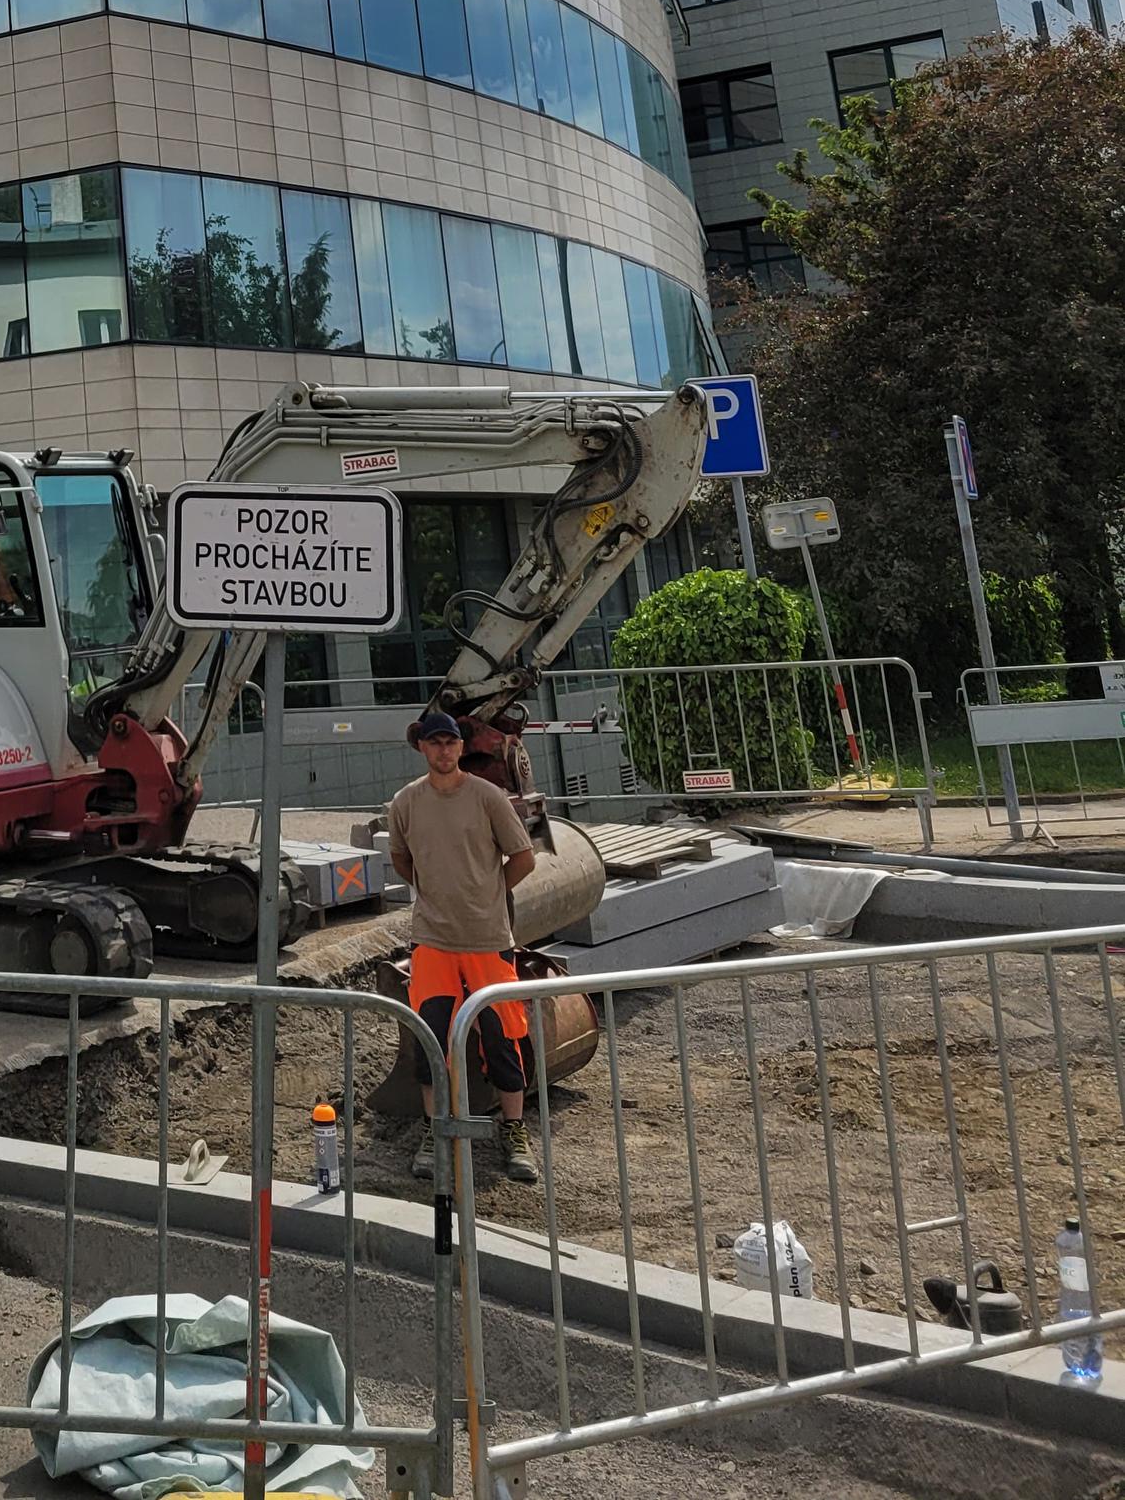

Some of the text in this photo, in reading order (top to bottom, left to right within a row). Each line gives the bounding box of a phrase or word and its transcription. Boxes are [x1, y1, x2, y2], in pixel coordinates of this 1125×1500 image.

[706, 387, 740, 440] P
[343, 455, 397, 471] STRABAG
[237, 508, 329, 535] POZOR
[195, 539, 372, 572] PROCHÁZÍTE
[220, 579, 347, 607] STAVBOU
[685, 776, 730, 786] STRABAG
